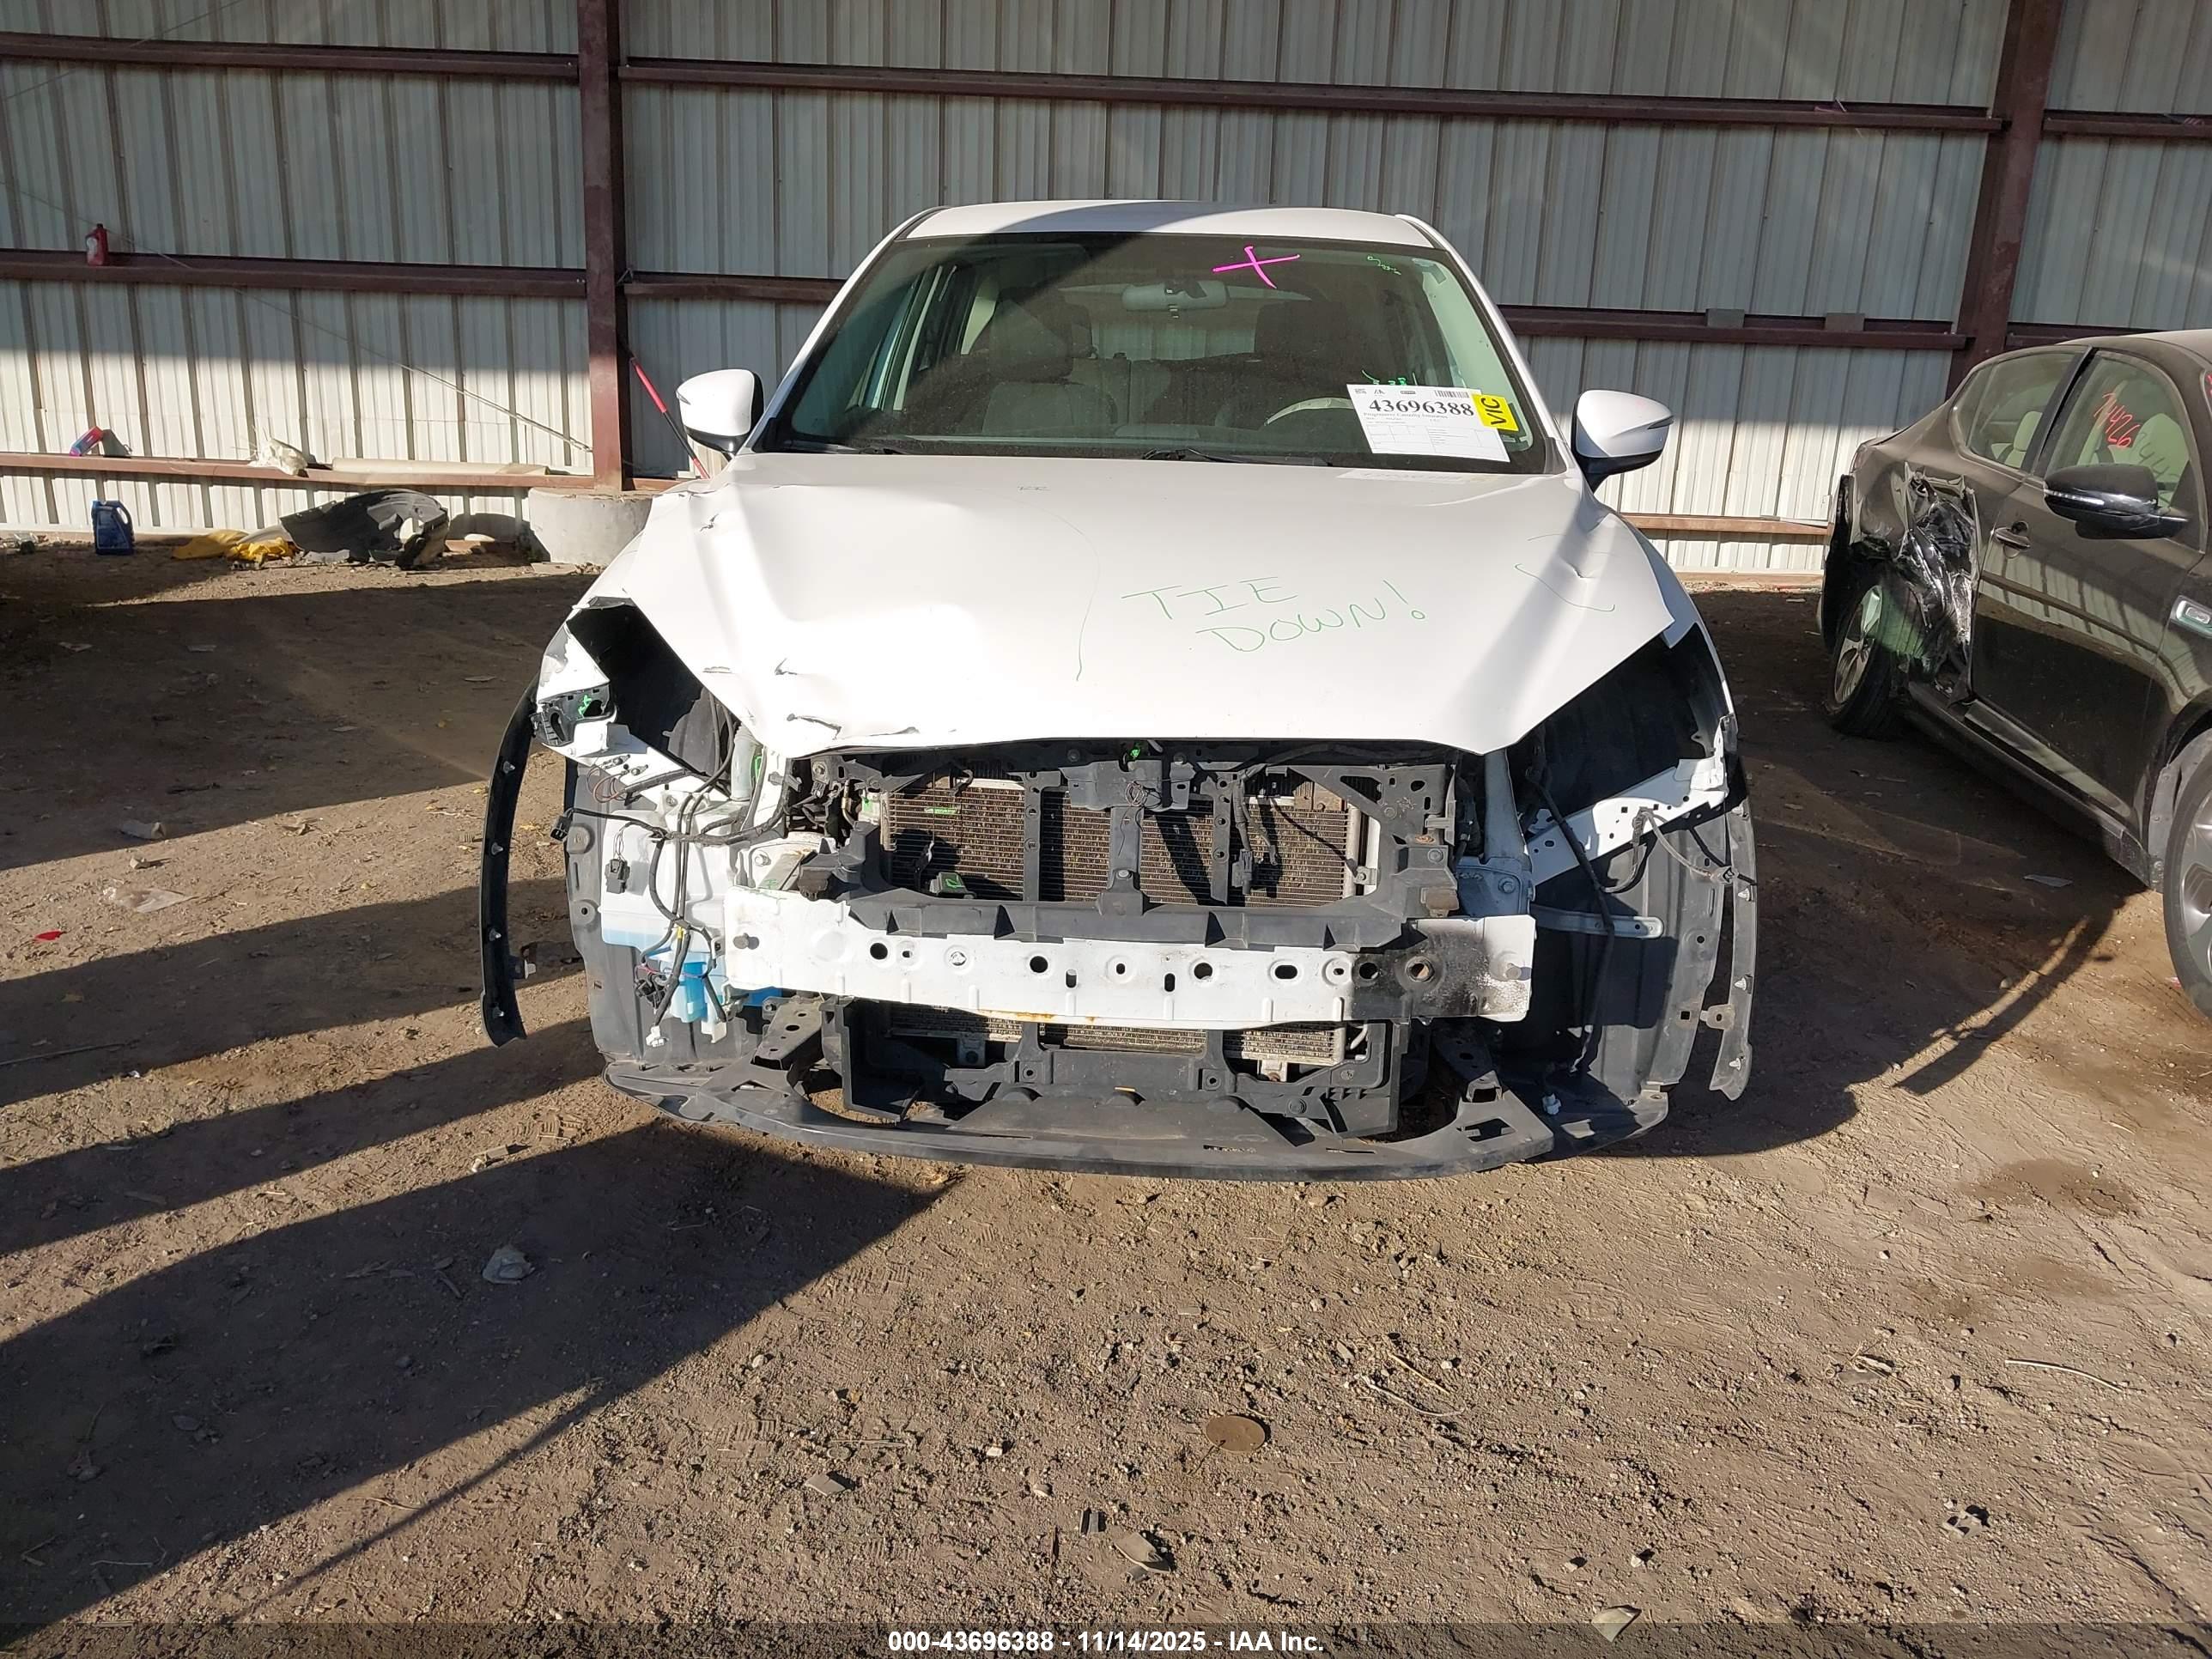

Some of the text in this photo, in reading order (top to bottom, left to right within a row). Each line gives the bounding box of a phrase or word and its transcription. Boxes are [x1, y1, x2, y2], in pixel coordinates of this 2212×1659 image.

[1369, 399, 1474, 416] 43696388
[1480, 398, 1508, 426] VIC
[1121, 576, 1298, 620] TIE
[1194, 580, 1426, 653] DOWN!
